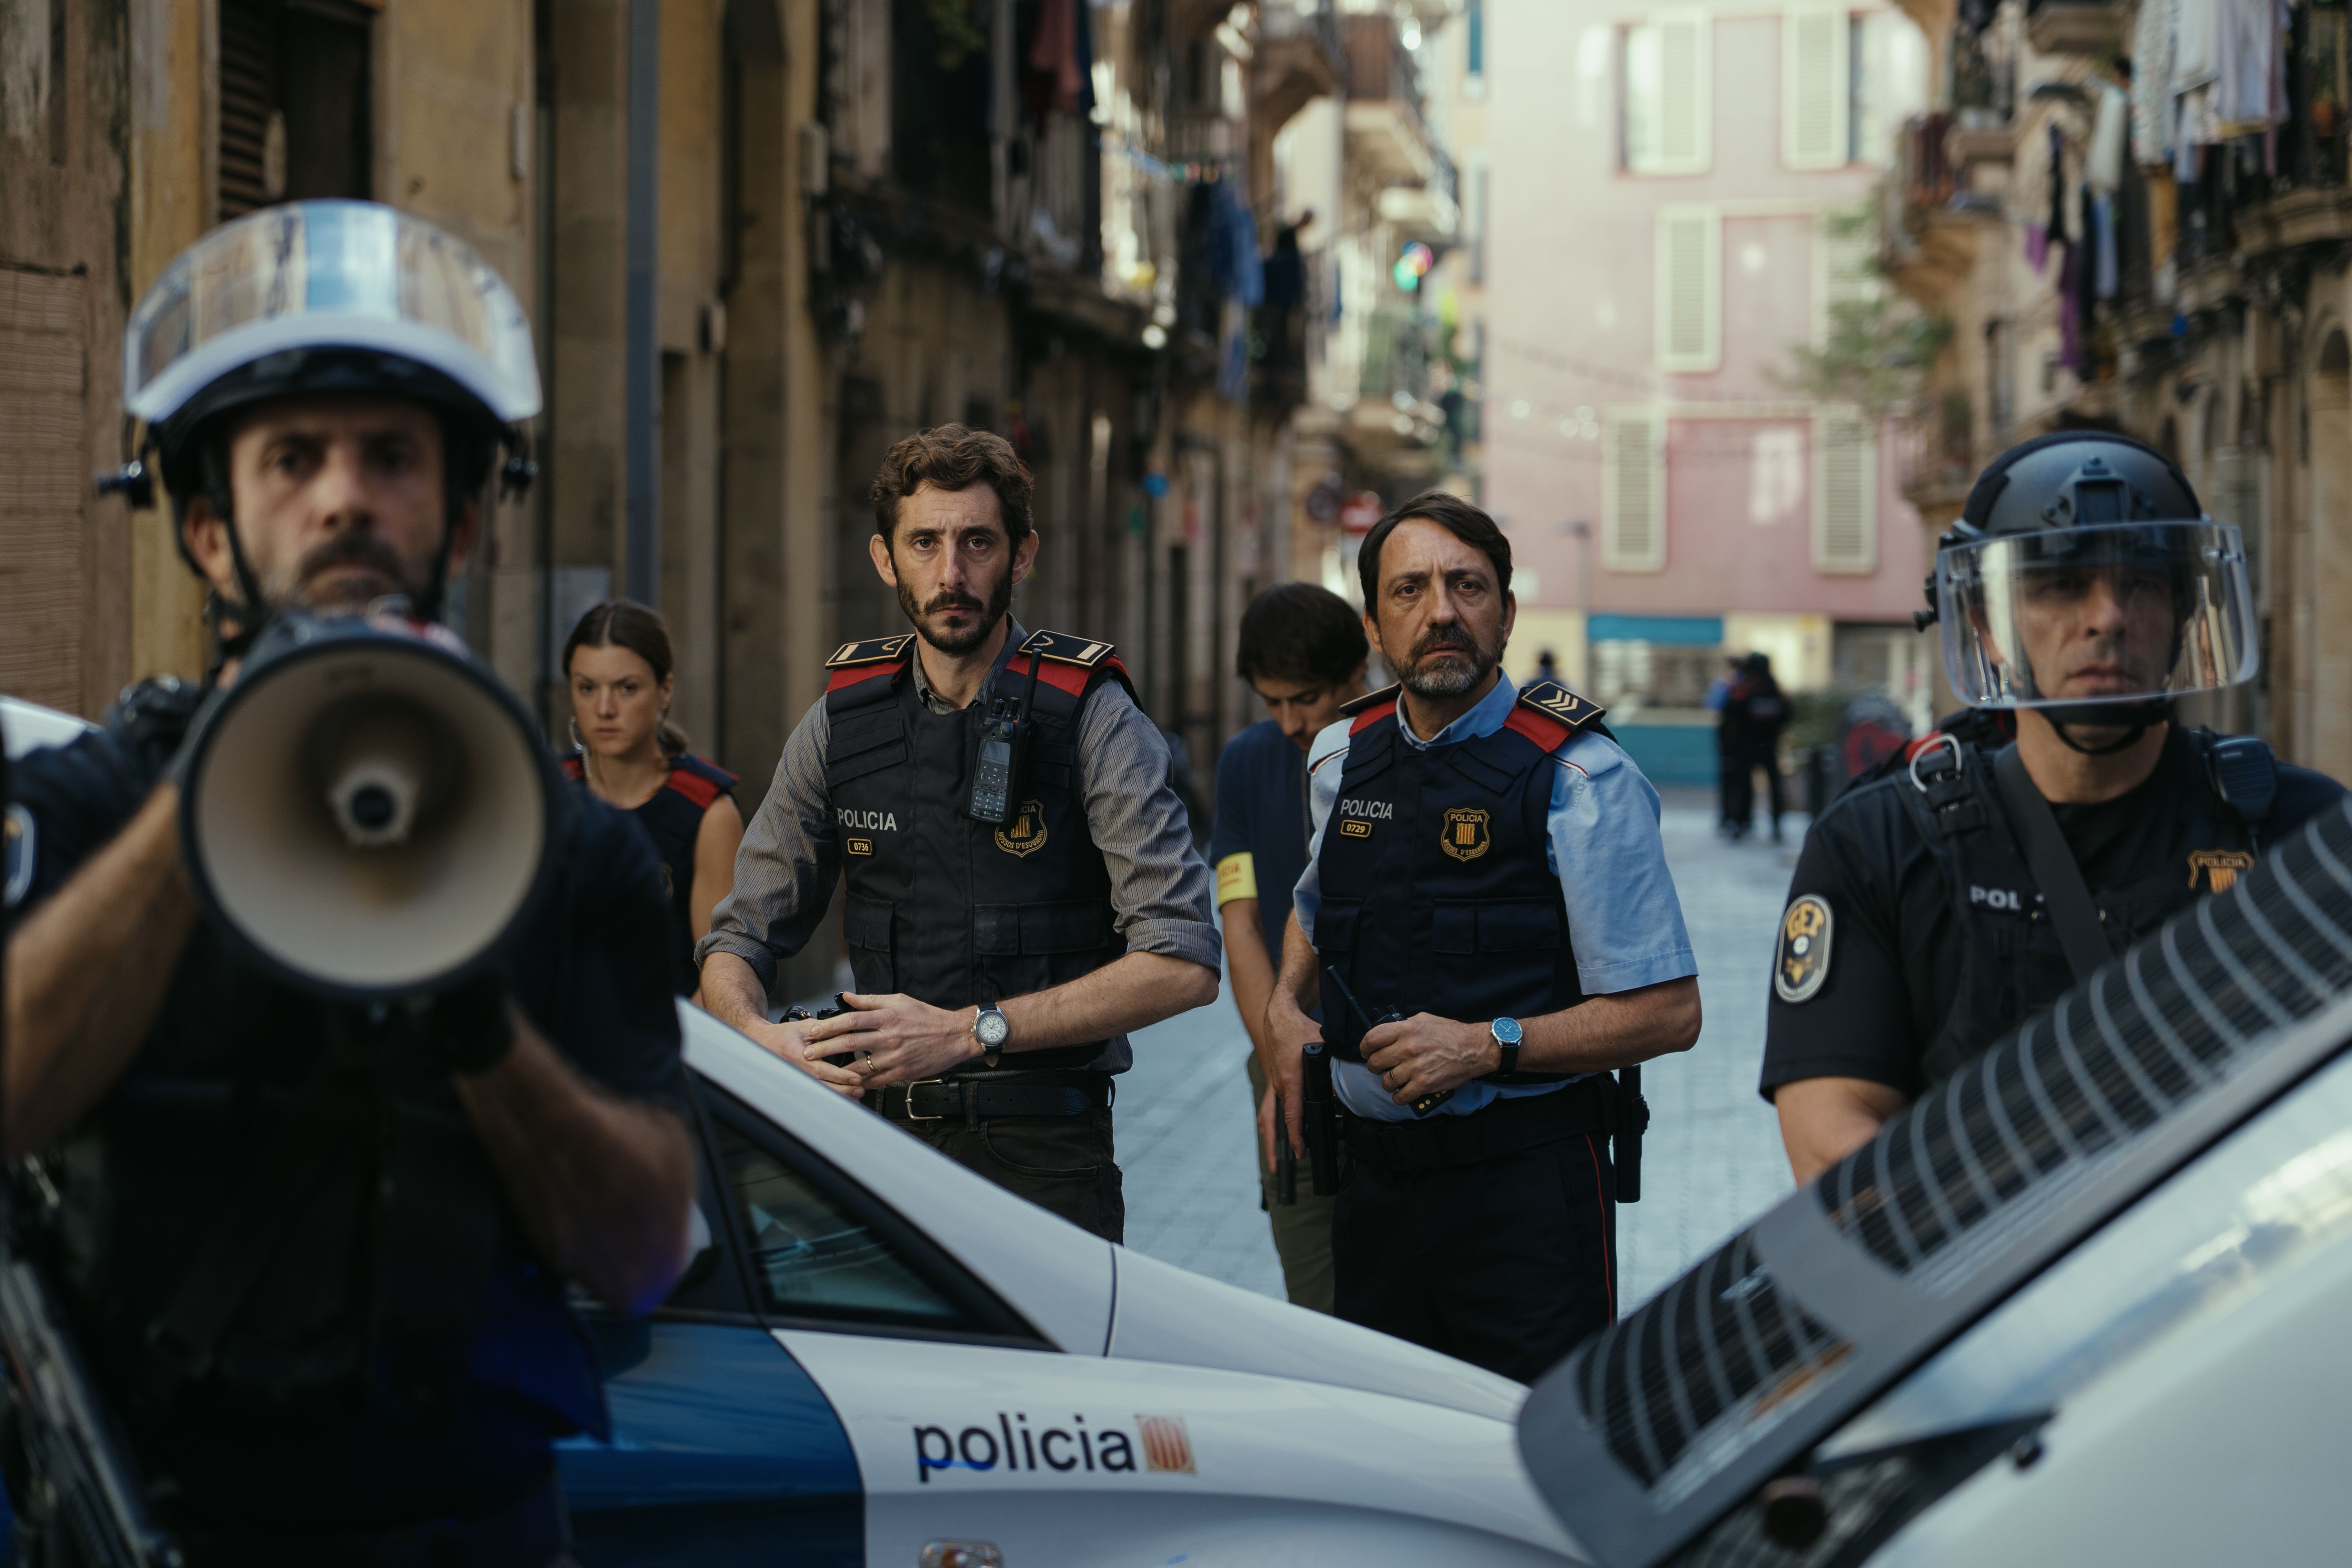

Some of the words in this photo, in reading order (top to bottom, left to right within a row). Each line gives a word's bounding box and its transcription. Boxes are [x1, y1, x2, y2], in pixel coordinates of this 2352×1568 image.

[1340, 799, 1393, 820] POLICIA
[1450, 813, 1483, 823] POLICIA
[837, 808, 897, 831] POLICIA
[1346, 824, 1366, 833] 0729
[854, 842, 869, 851] 0736
[998, 832, 1014, 849] MOSSOS
[1016, 829, 1044, 849] D'ESQUADRA
[1444, 838, 1458, 855] MOSSOS
[1461, 840, 1487, 855] D'ESQUADRA
[913, 1412, 1136, 1484] policia
